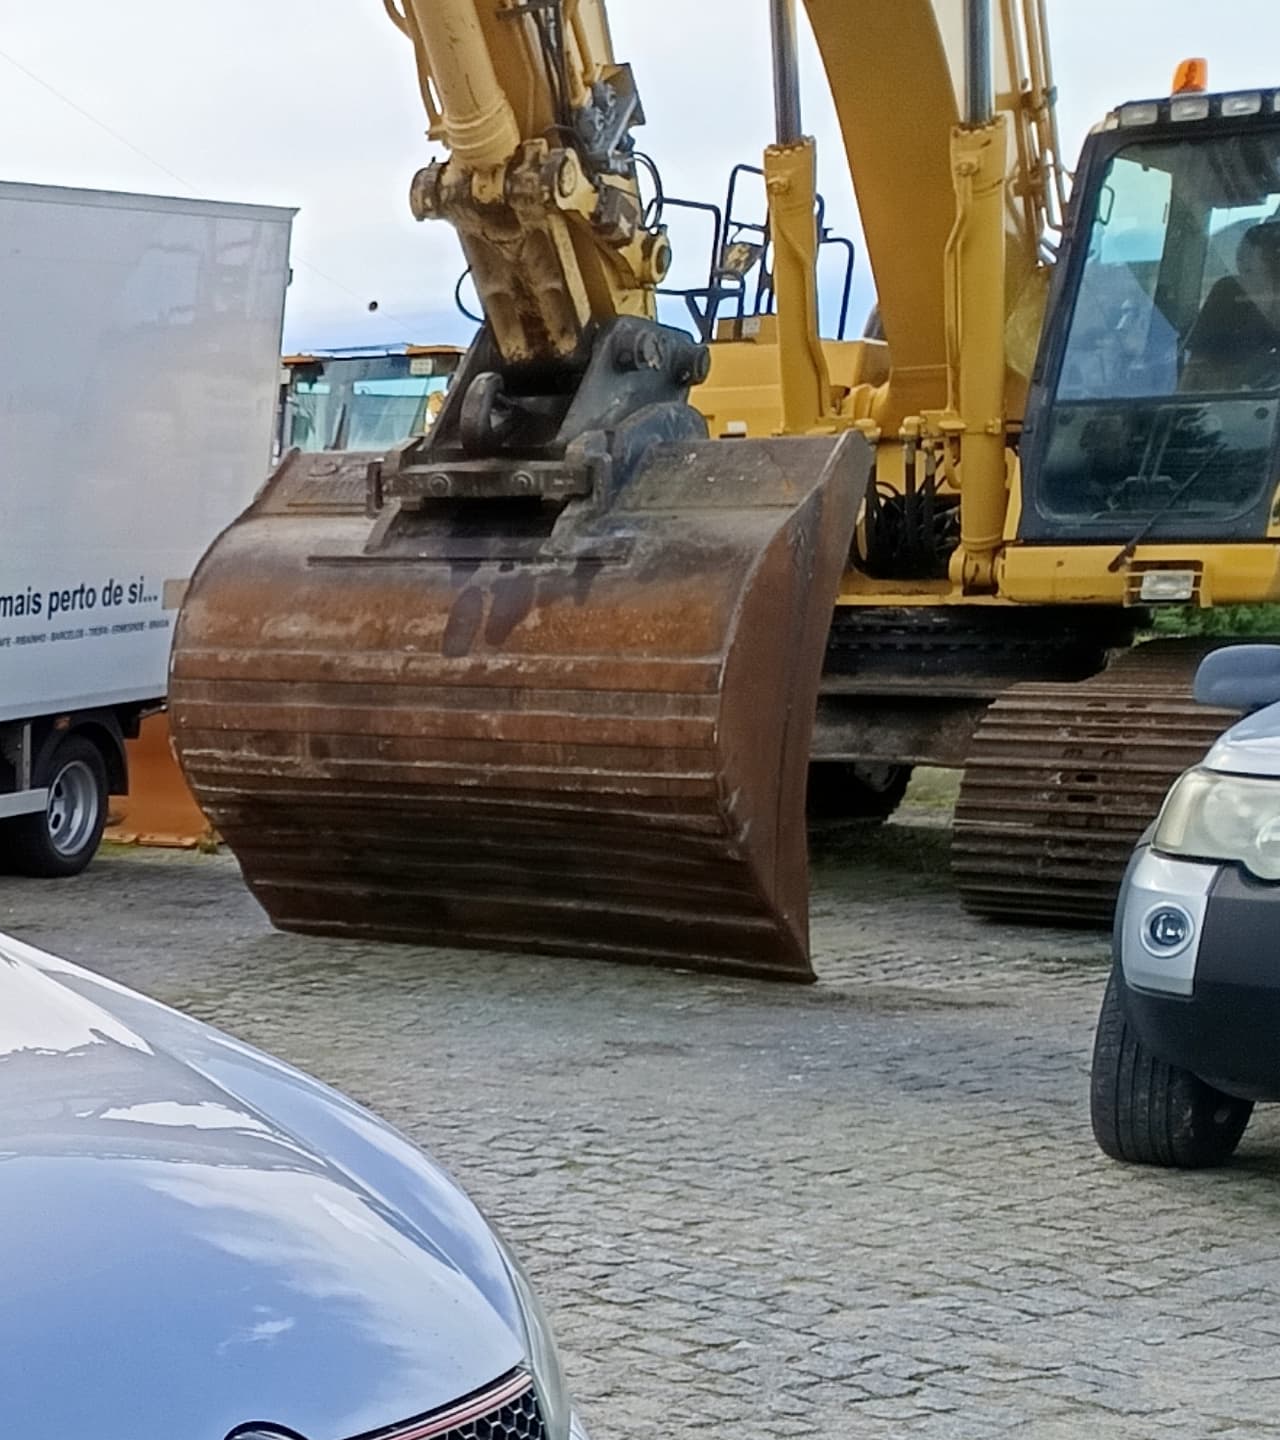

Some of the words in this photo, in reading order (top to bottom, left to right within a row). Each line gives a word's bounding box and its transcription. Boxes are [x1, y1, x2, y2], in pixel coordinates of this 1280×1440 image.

[48, 583, 97, 620] perto
[102, 578, 124, 607] de
[128, 575, 158, 604] si...
